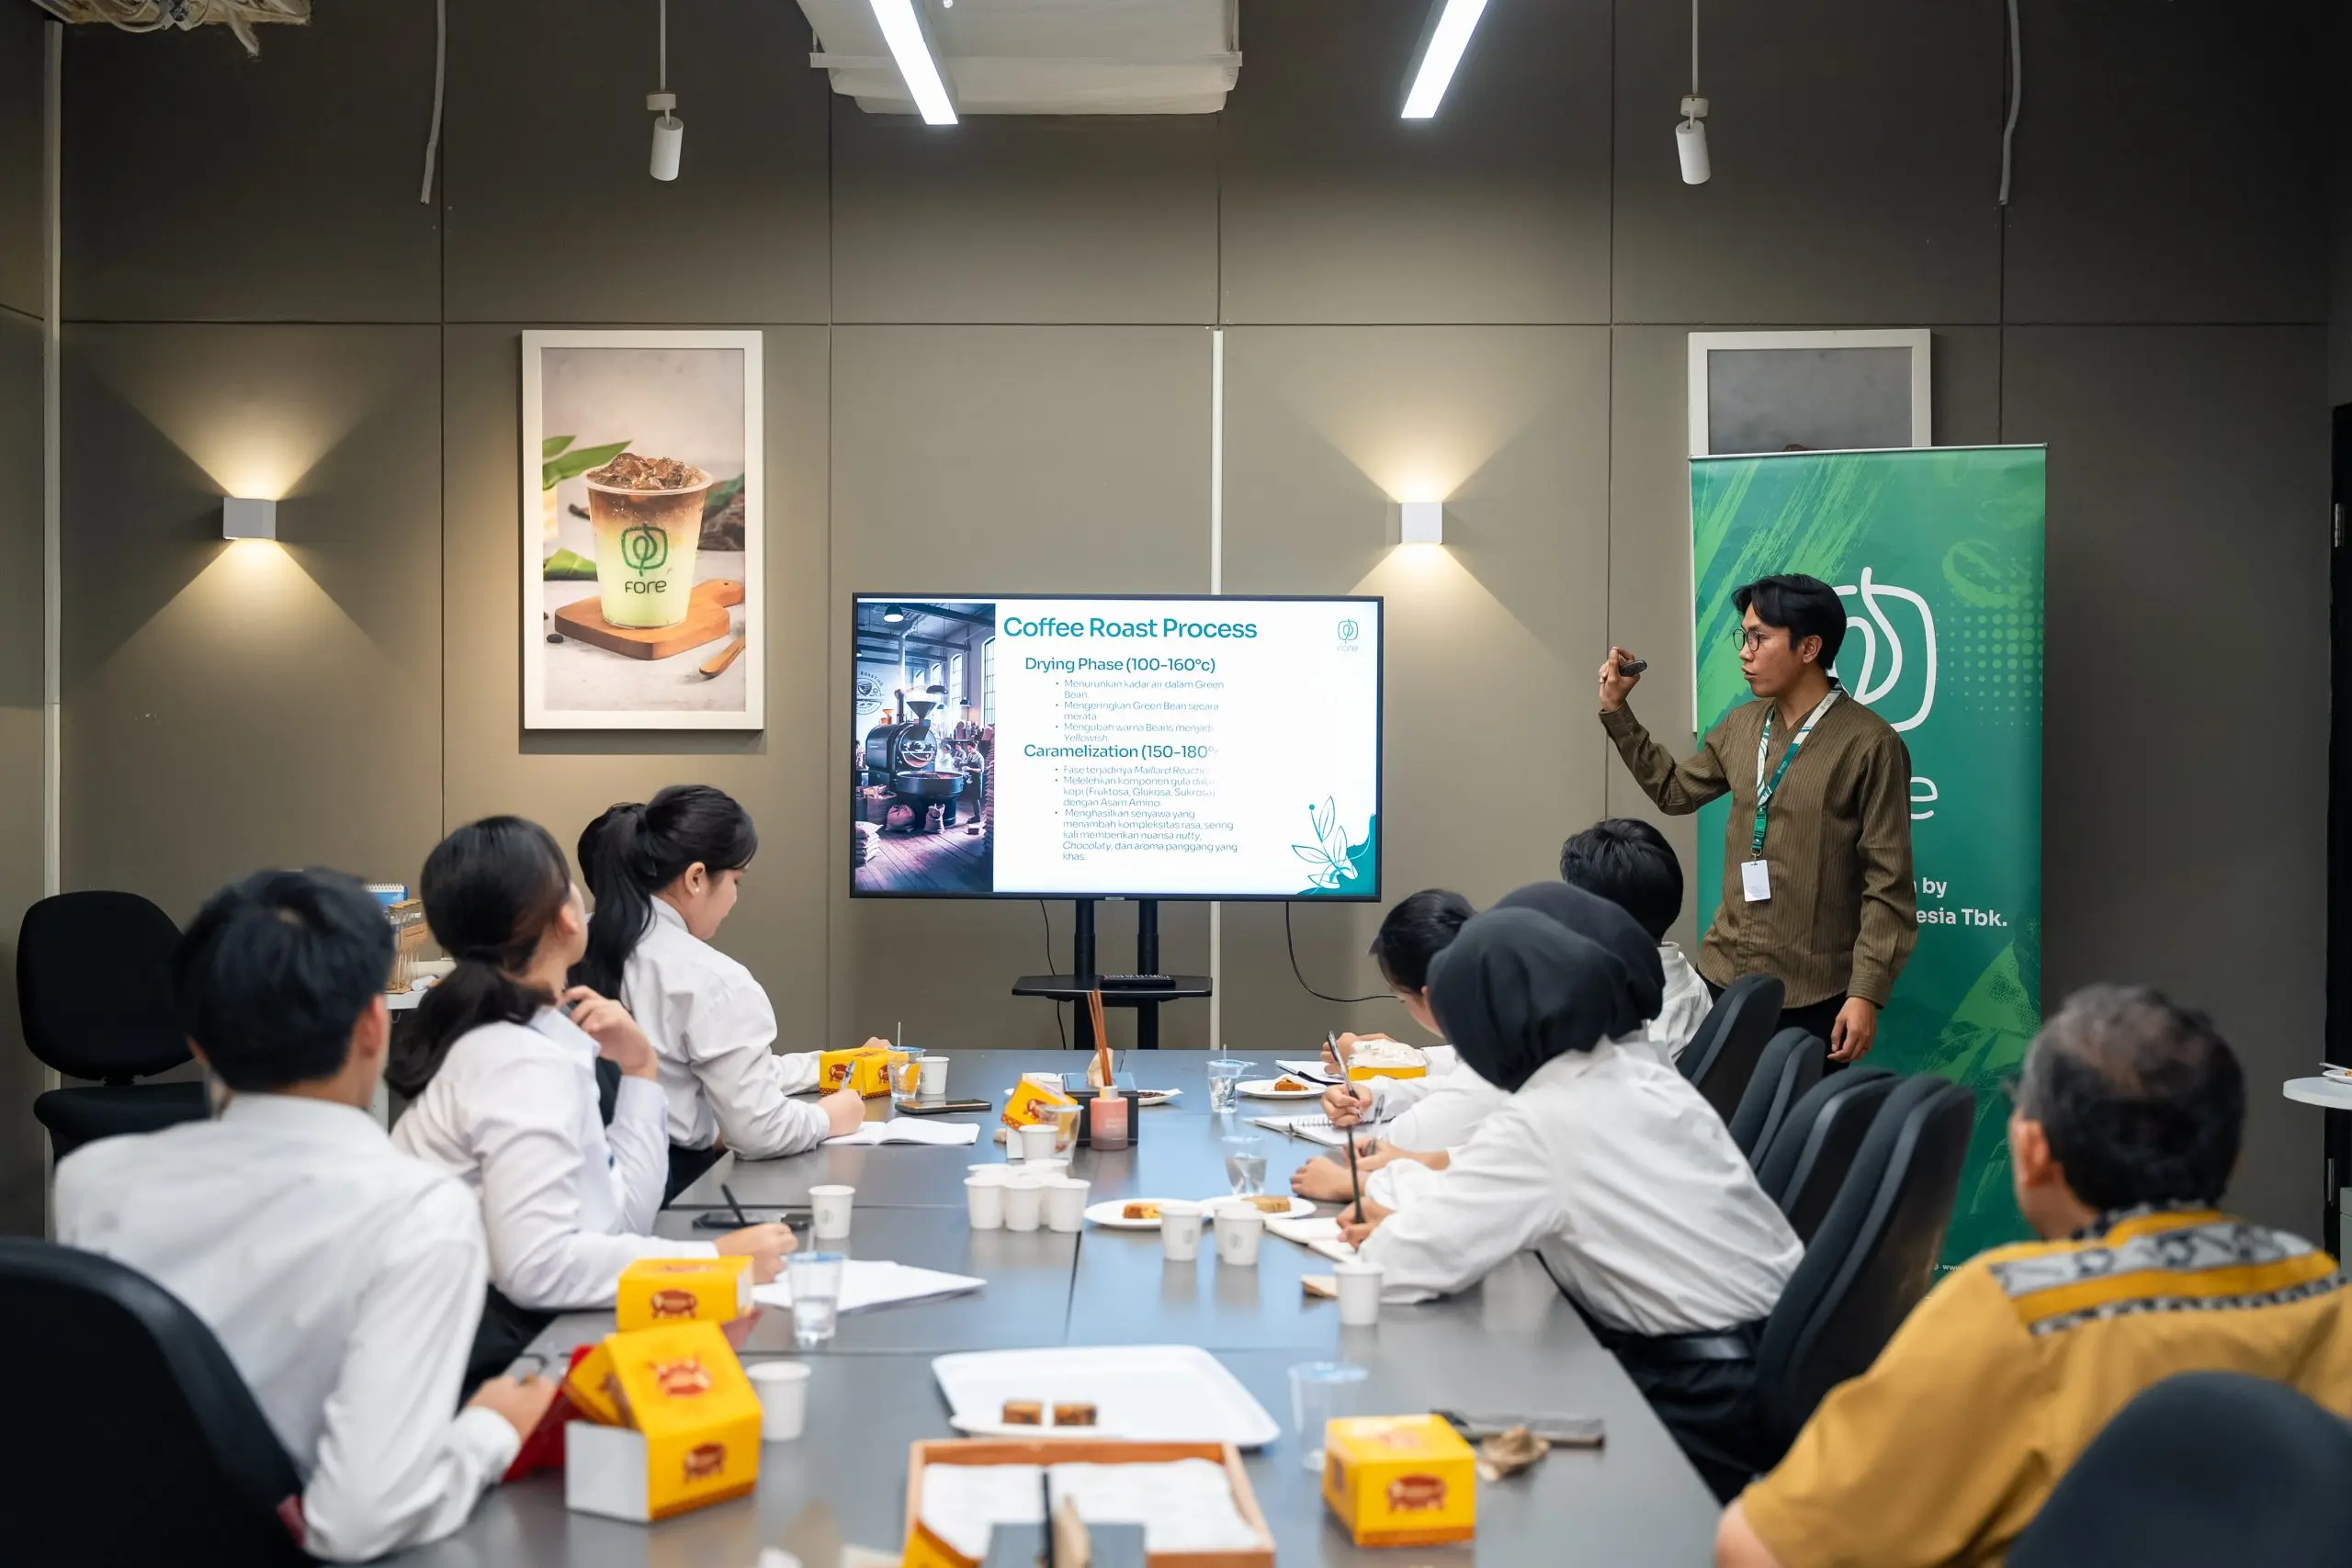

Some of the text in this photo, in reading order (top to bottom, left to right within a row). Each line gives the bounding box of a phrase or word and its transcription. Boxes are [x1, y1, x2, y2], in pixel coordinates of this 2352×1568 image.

[1003, 617, 1257, 638] Coffee Roast Process
[1025, 658, 1075, 673] Drying
[1079, 658, 1123, 671] Phase
[1065, 680, 1122, 688] Menurunkan
[1124, 680, 1150, 688] kadar
[1195, 681, 1224, 689] Green
[1064, 702, 1131, 711] Mengeringkan
[1133, 702, 1161, 710] Green
[1164, 702, 1186, 710] Bean
[1064, 723, 1114, 732] Mengubah
[1064, 734, 1108, 742] Yellowish
[1023, 744, 1138, 758] Caramelization
[1087, 766, 1132, 775] terjadinya
[1134, 766, 1170, 774] Maillard
[1064, 776, 1116, 784] Melelehkan
[1118, 777, 1169, 786] komponen
[1170, 777, 1190, 786] gula
[1064, 787, 1084, 796] kopi
[1064, 798, 1098, 807] dengan
[1101, 798, 1126, 807] Asam
[1065, 809, 1194, 819] Menghasilkan senyawa yang
[1118, 821, 1180, 829] kompleksitas
[1204, 821, 1234, 830] sering
[1080, 831, 1138, 840] memberikan
[1176, 832, 1202, 841] nutty,
[1063, 841, 1238, 852] Chocolaty, dan aroma panggang yang
[1063, 852, 1086, 861] khas.
[1922, 877, 1948, 898] by
[1961, 908, 2007, 927] Tbk.
